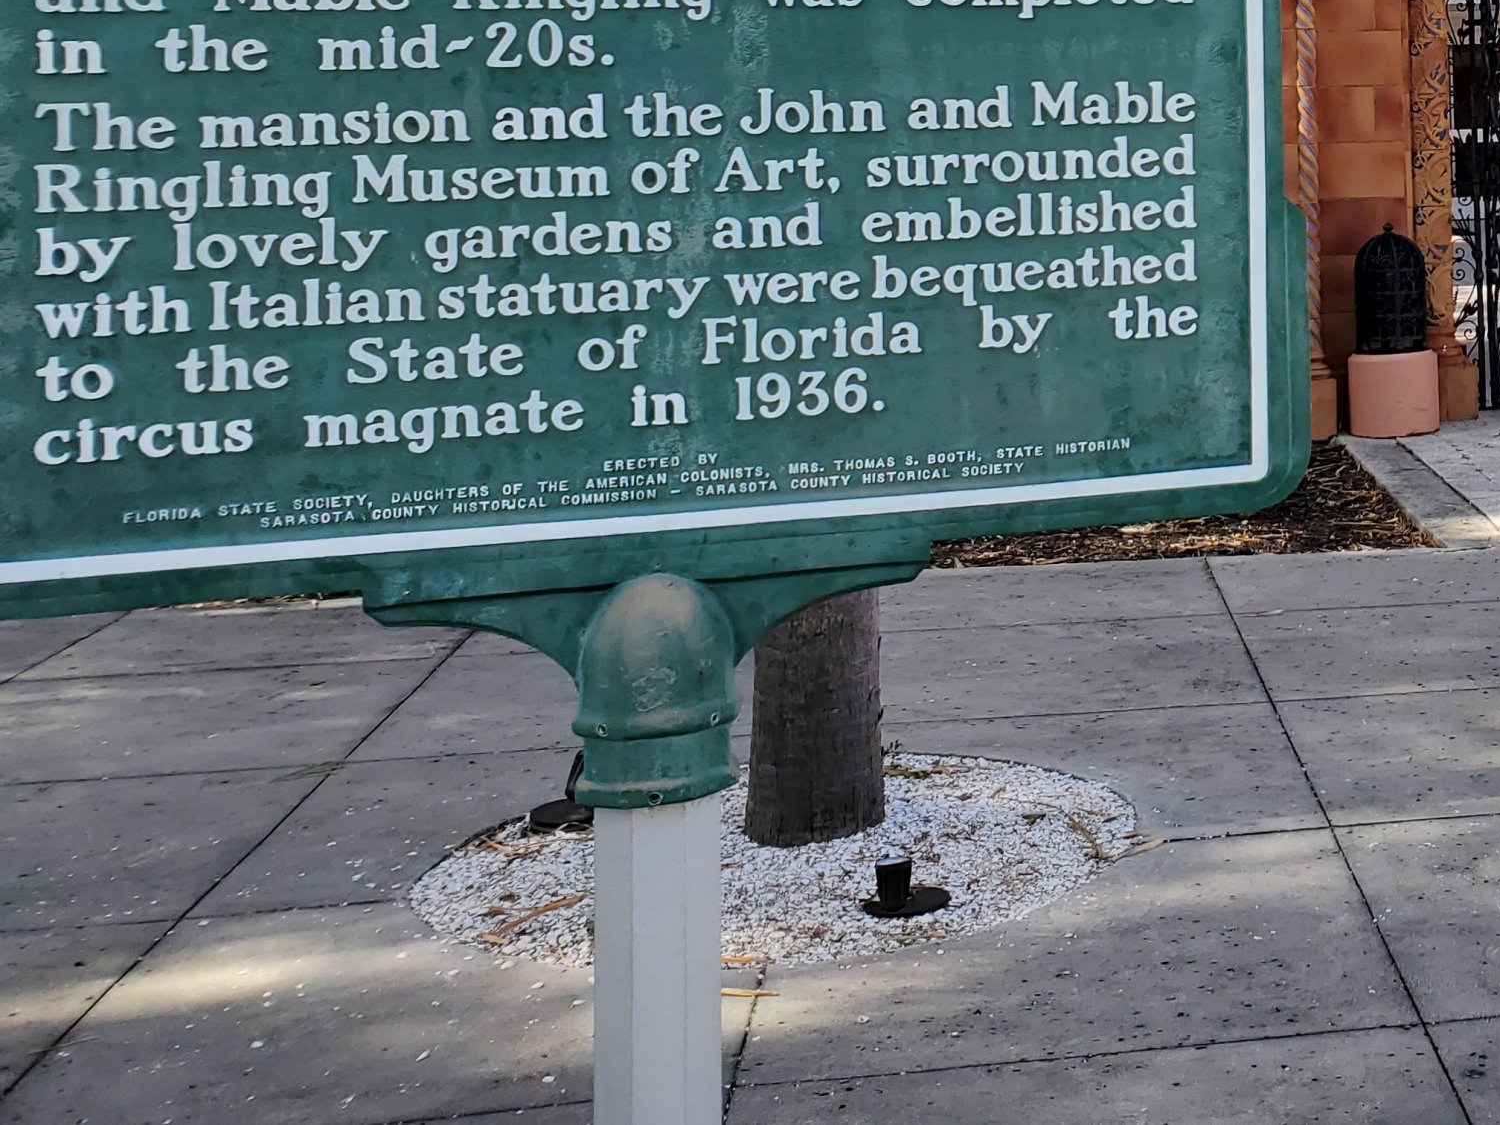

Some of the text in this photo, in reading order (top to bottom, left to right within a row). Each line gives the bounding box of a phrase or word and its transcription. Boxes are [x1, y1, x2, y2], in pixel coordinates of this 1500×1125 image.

[37, 30, 105, 73] in
[156, 25, 267, 71] the
[36, 82, 1195, 151] The mansion and the John and Mable
[35, 134, 1195, 221] Ringling Museum of Art, surrounded
[36, 186, 1197, 282] by lovely gardens and embellished
[36, 240, 1197, 338] with Italian statuary were bequeathed
[37, 296, 1197, 401] to the State of Florida by the
[35, 368, 883, 464] circus magnate in 1936.
[122, 508, 202, 524] FLORIDA
[217, 501, 277, 517] STATE
[391, 483, 490, 504] DAUGHTERS
[501, 483, 524, 495] OF
[537, 480, 569, 493] THE
[585, 473, 668, 490] AMERICAN
[833, 457, 896, 471] THOMAS
[996, 446, 1044, 460] STATE
[1055, 438, 1131, 454] HISTORIAN
[259, 511, 355, 528] SARASOTA
[371, 504, 439, 521] COUNTY
[452, 495, 548, 514] HISTORICAL
[560, 488, 658, 507] COMMISSION
[695, 480, 779, 497] SARASOTA
[789, 473, 850, 490] COUNTY
[861, 467, 951, 485] HISTORICAL
[961, 462, 1024, 478] SOCIETY
[603, 453, 719, 472] ERECTED BY
